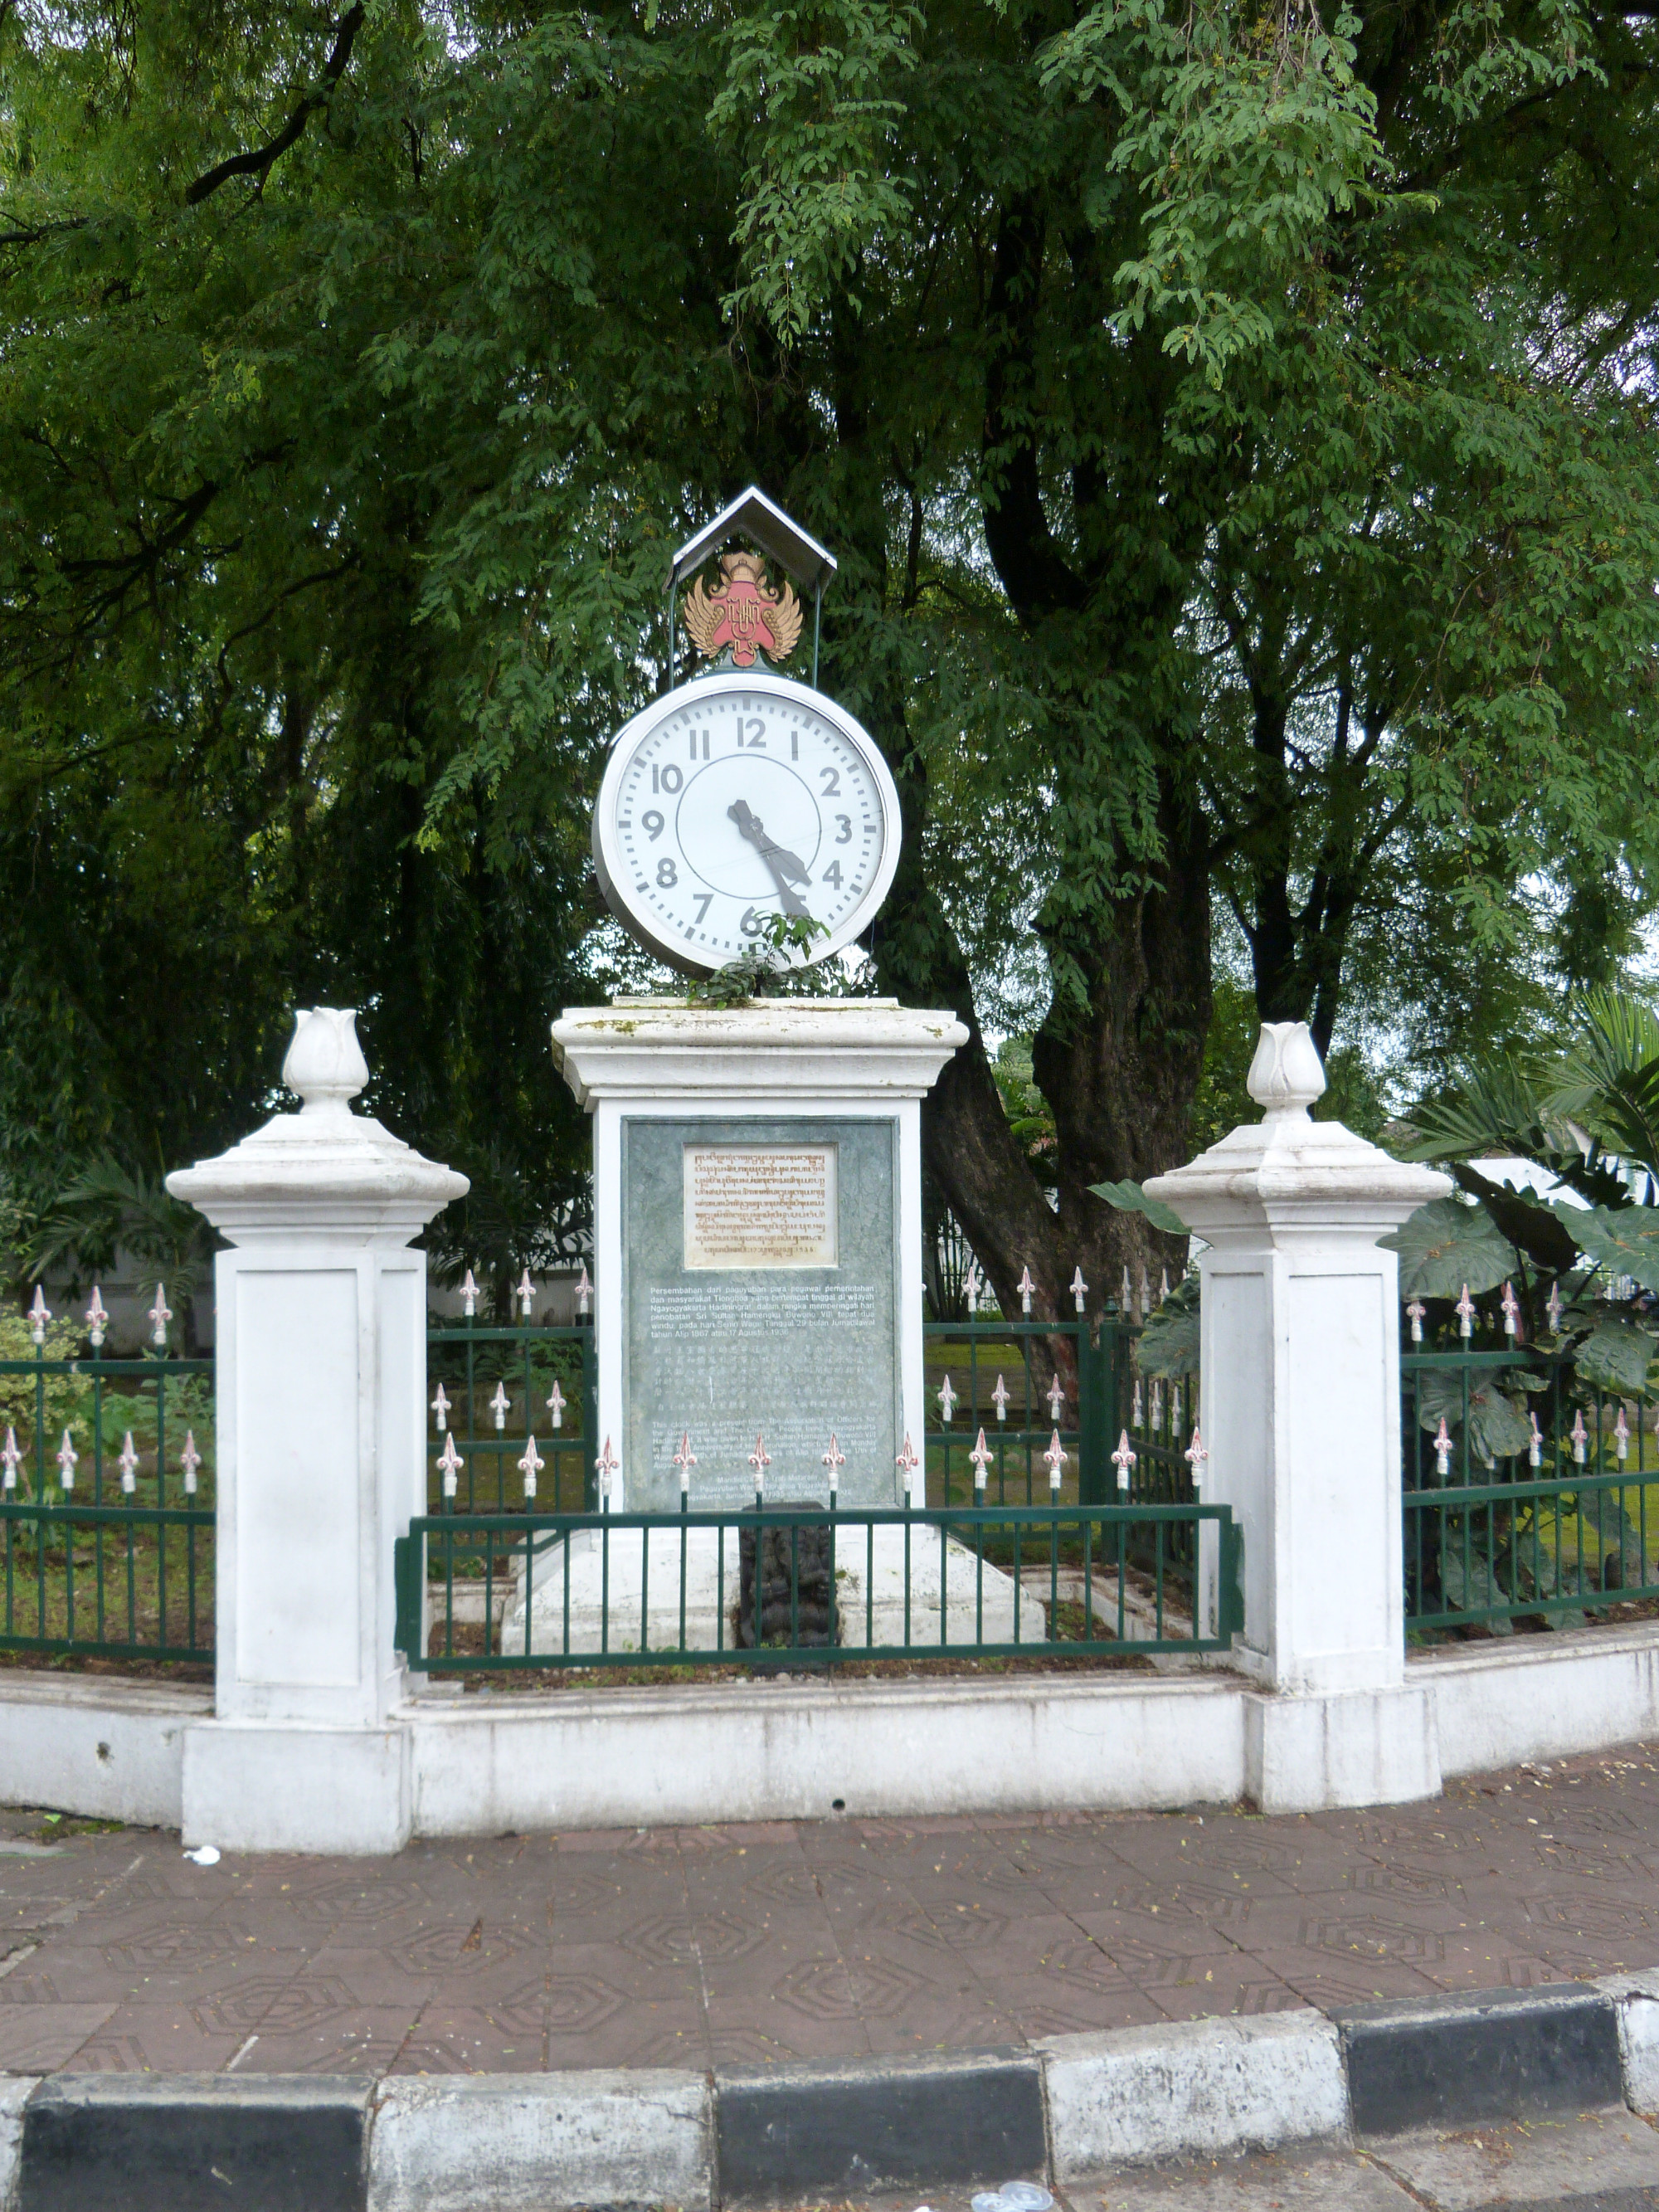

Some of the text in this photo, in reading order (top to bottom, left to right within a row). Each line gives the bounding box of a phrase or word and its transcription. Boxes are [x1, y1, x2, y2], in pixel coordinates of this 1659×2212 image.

[689, 729, 710, 760] 11
[737, 717, 766, 748] 12
[791, 731, 799, 761] 1
[652, 763, 684, 795] 10
[819, 767, 841, 797] 2
[641, 810, 664, 842] 9
[834, 814, 853, 844] 3
[656, 857, 678, 889] 8
[822, 860, 844, 890] 4
[693, 894, 714, 924] 7
[740, 906, 763, 938] 6
[668, 1295, 711, 1304] masyarakat
[751, 1294, 769, 1303] yang
[771, 1294, 809, 1303] bertempat
[811, 1294, 835, 1302] tinggal
[847, 1293, 874, 1302] wilayah
[725, 1286, 766, 1295] paguyuban
[770, 1286, 786, 1294] para
[791, 1285, 821, 1294] pegawai
[825, 1284, 874, 1294] pemerintahan
[650, 1304, 706, 1313] Ngayogyakarta
[781, 1303, 806, 1311] rangka
[809, 1302, 859, 1311] memperingati
[650, 1313, 691, 1322] penobatan
[741, 1312, 781, 1320] Hamengku
[837, 1310, 857, 1319] tepat
[679, 1322, 698, 1330] pada
[738, 1328, 769, 1337] Agustus
[670, 1420, 690, 1428] clock
